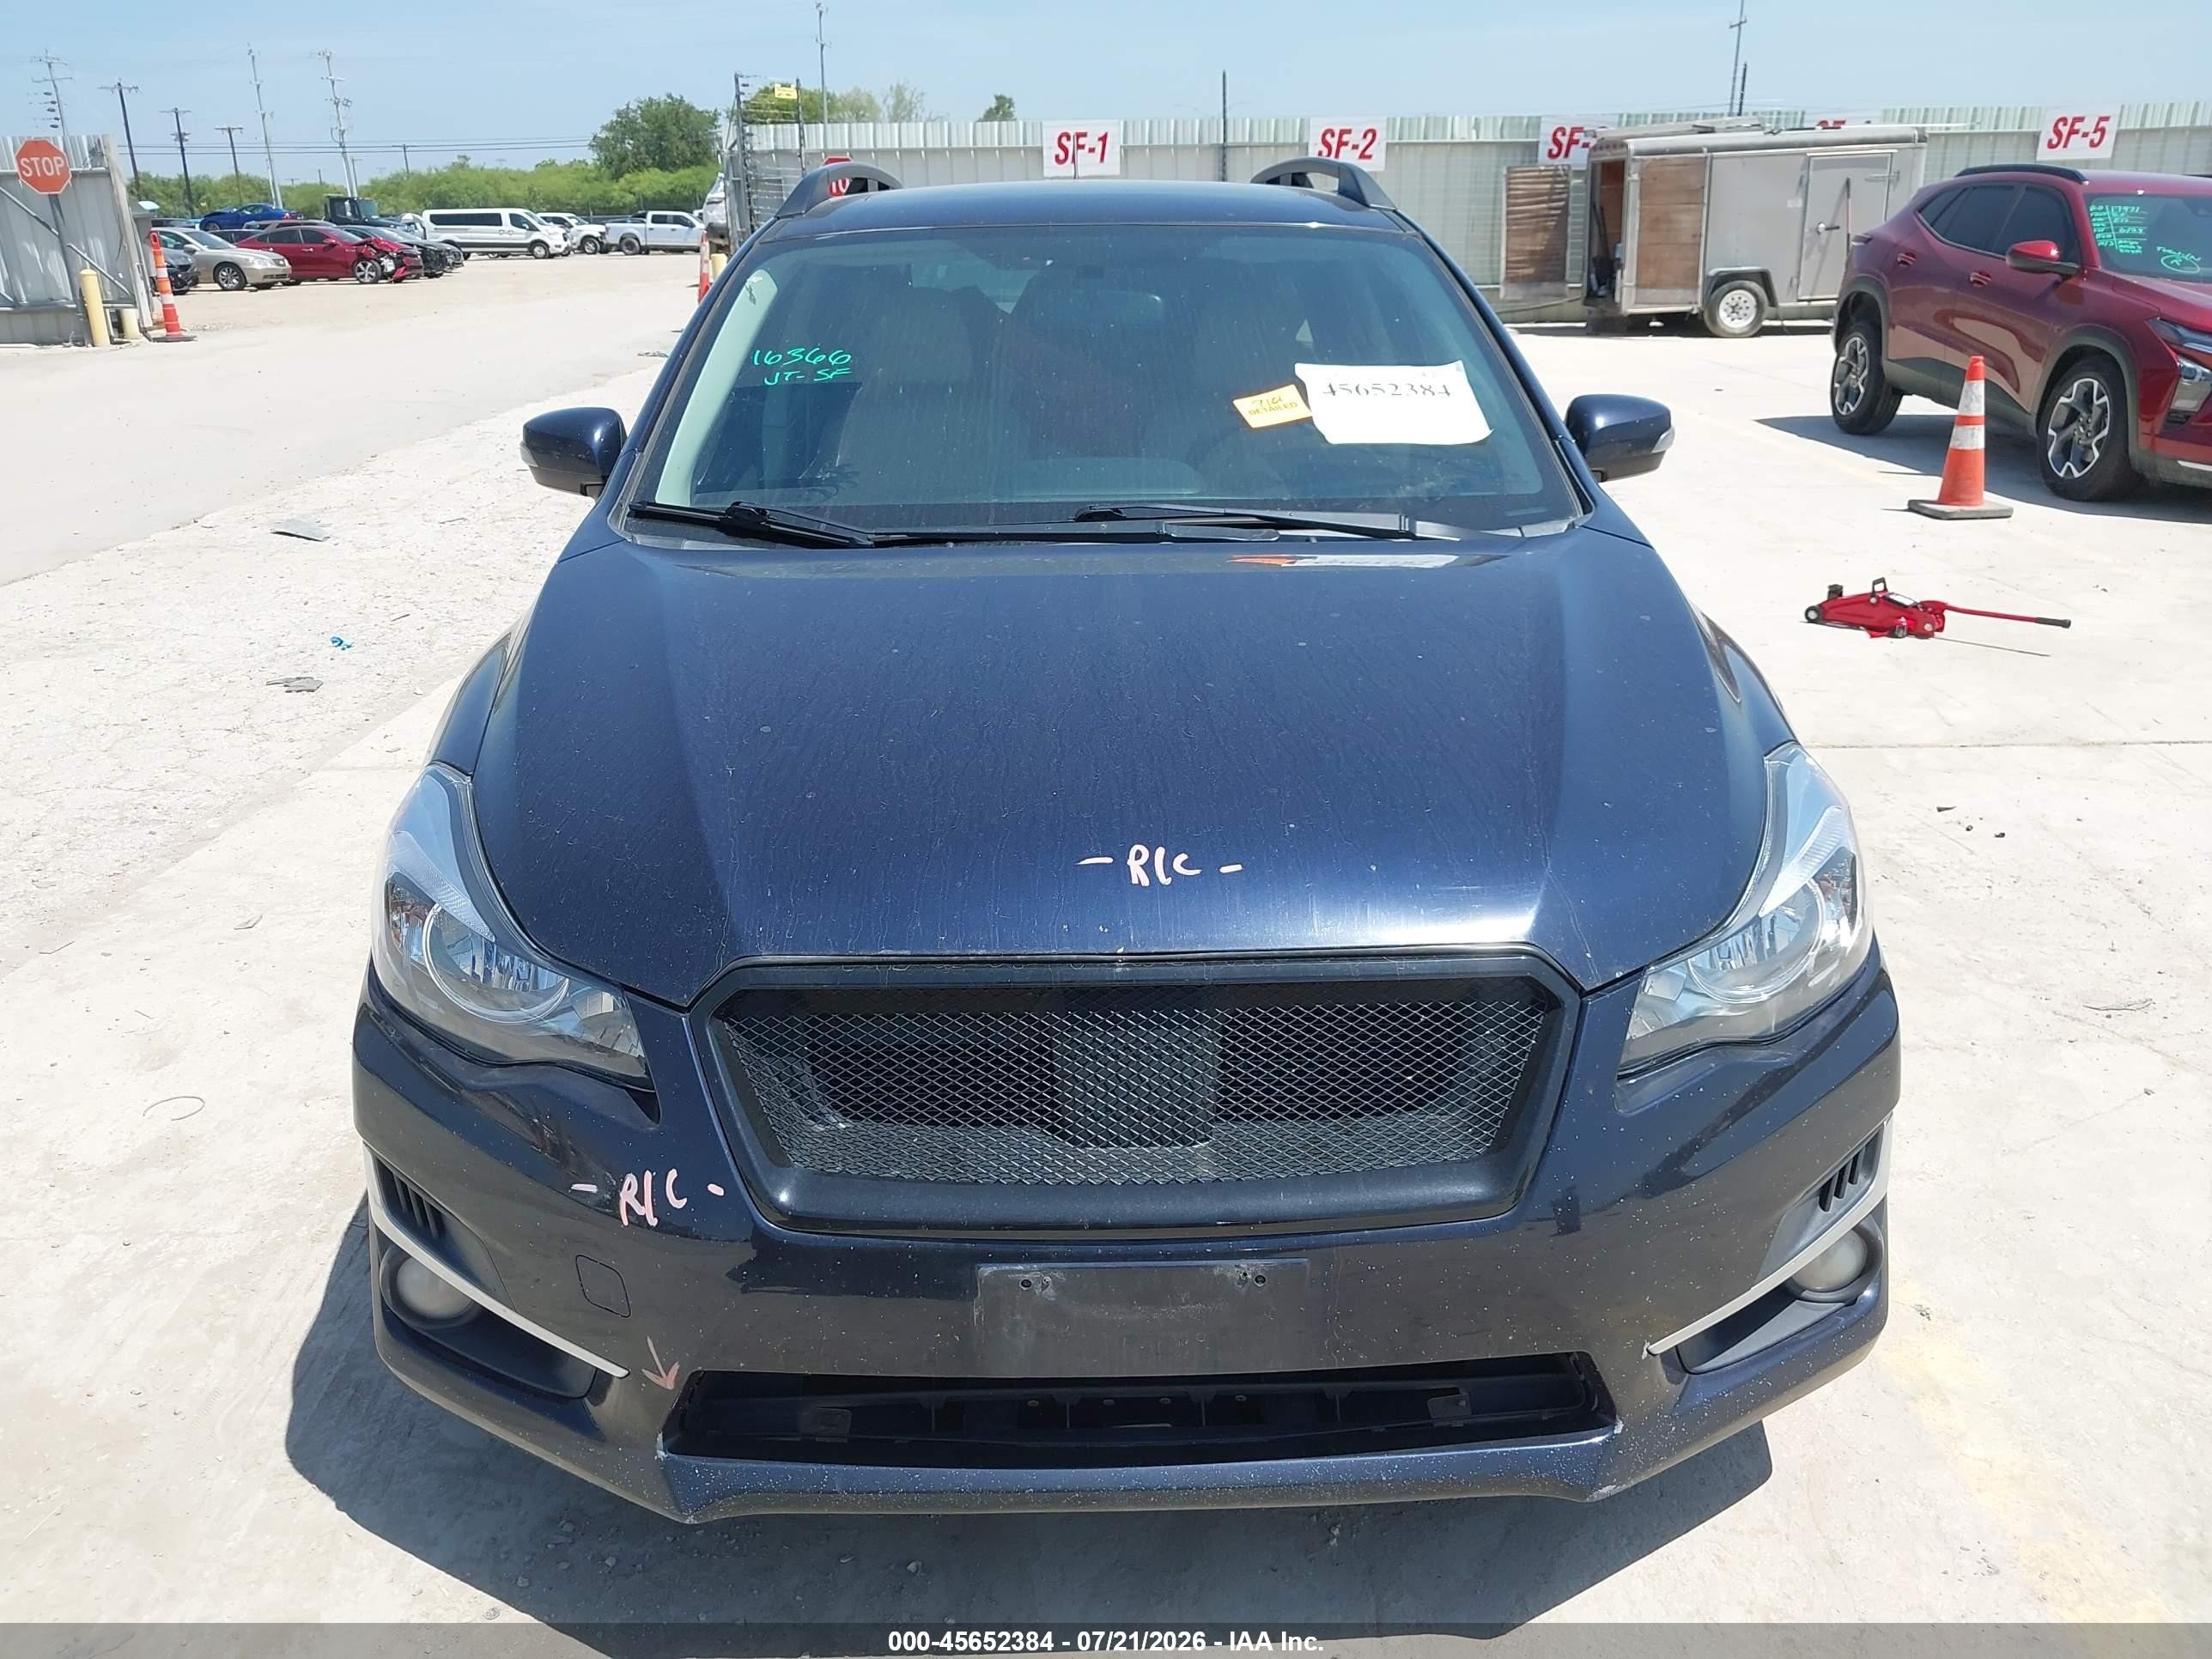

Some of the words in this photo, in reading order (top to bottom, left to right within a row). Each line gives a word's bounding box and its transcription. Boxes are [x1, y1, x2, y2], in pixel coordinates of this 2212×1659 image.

[1317, 128, 1377, 160] SF-2
[1547, 126, 1590, 160] SF-
[2046, 115, 2112, 149] SF-5
[1054, 131, 1109, 166] SF-1
[20, 156, 64, 178] STOP
[753, 347, 852, 366] 16366
[1322, 381, 1451, 398] 45652384
[1249, 401, 1298, 416] DETAILED
